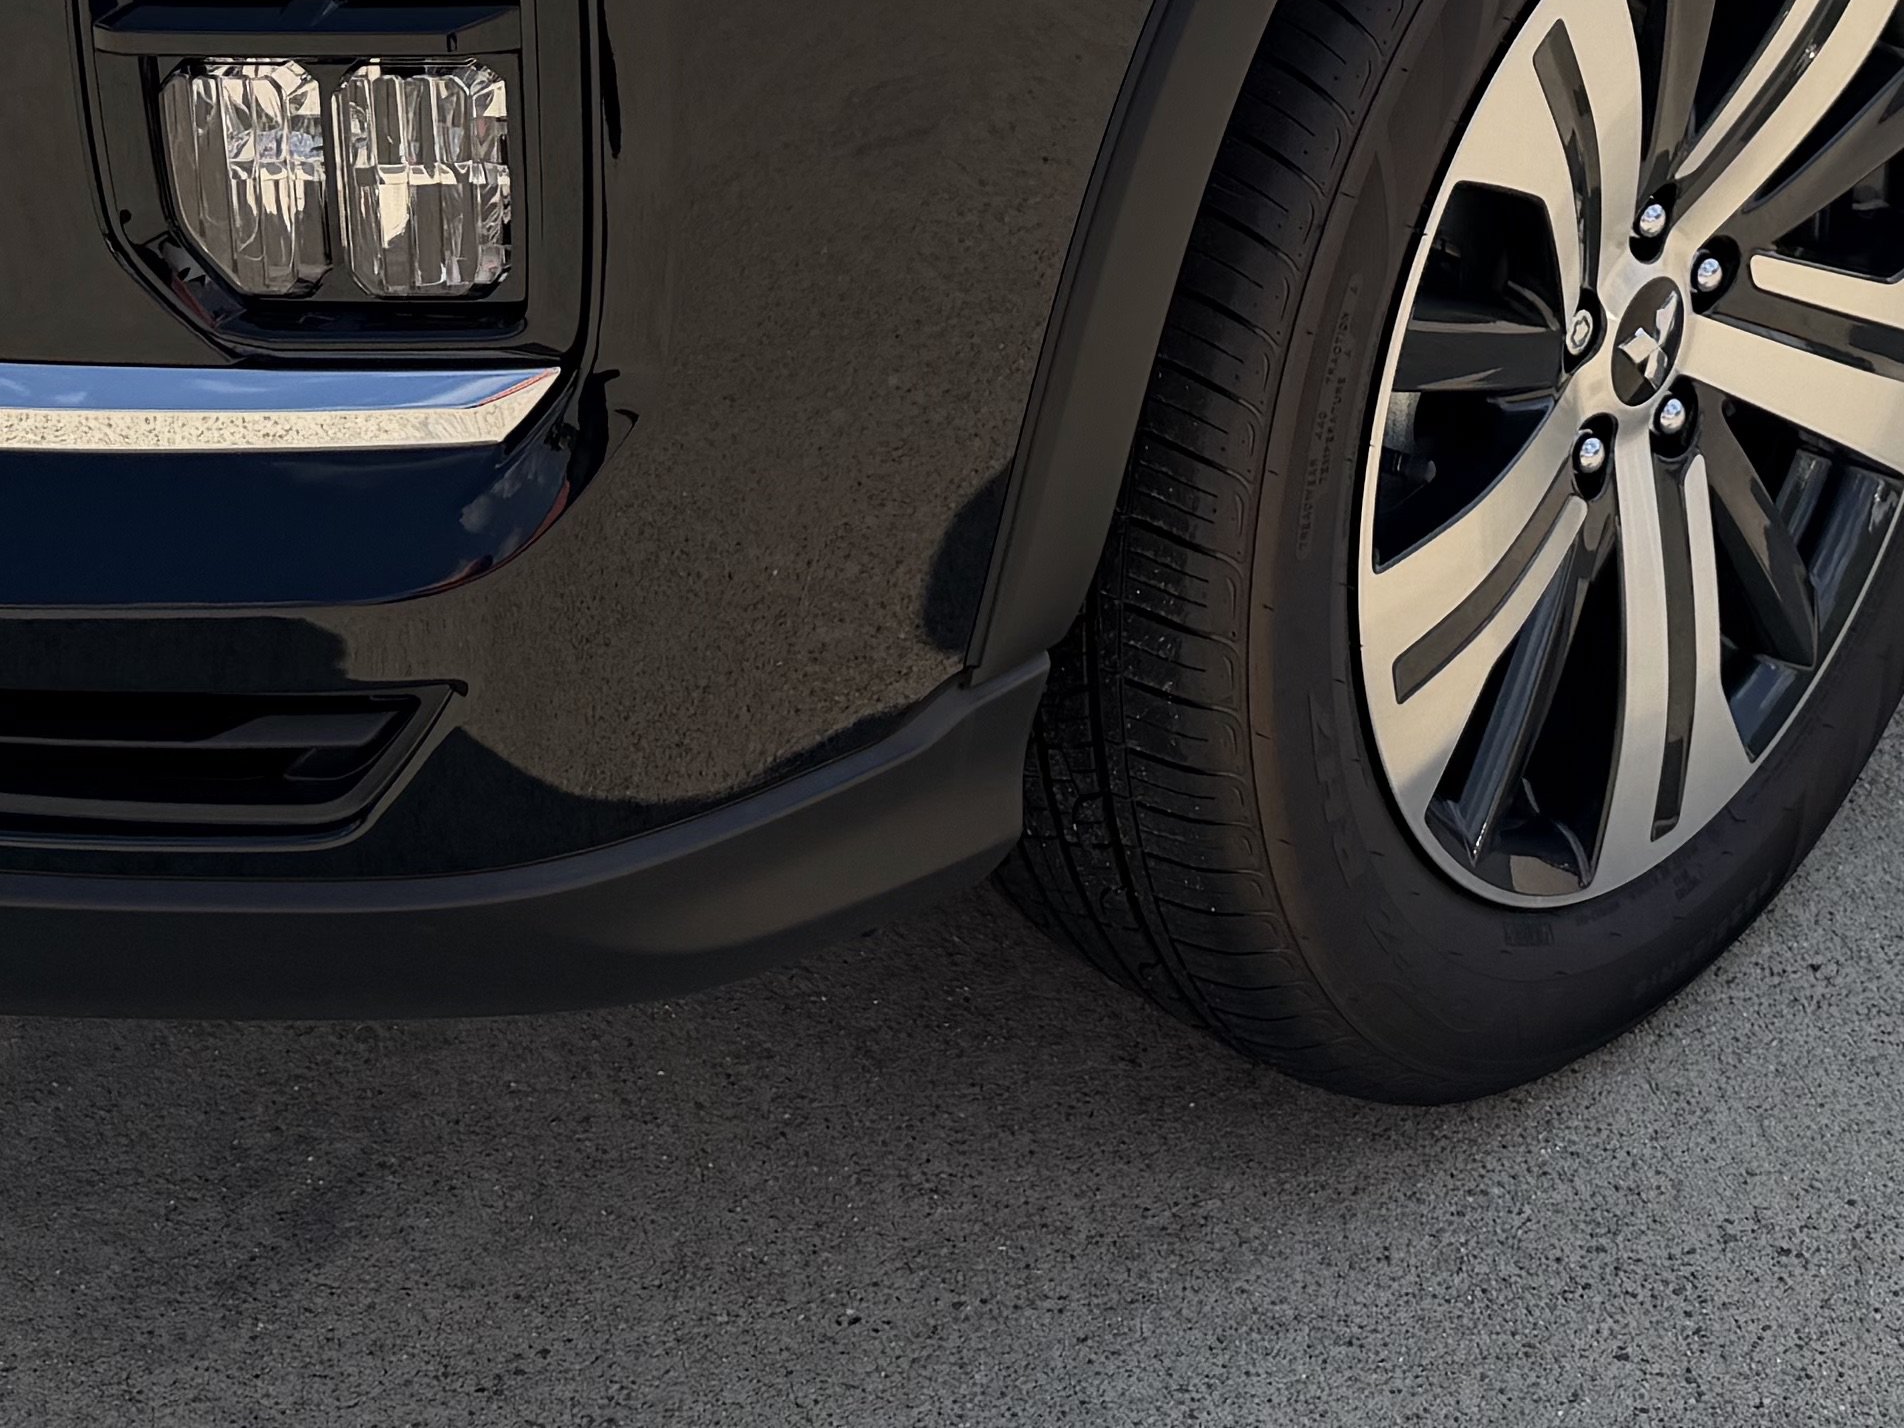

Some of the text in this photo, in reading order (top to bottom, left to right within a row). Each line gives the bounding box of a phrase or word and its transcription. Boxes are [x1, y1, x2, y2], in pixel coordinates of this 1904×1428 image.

[1297, 458, 1319, 552] TREADWEAR
[1324, 312, 1350, 385] TRACTION
[1317, 376, 1347, 485] TEMPERATURE
